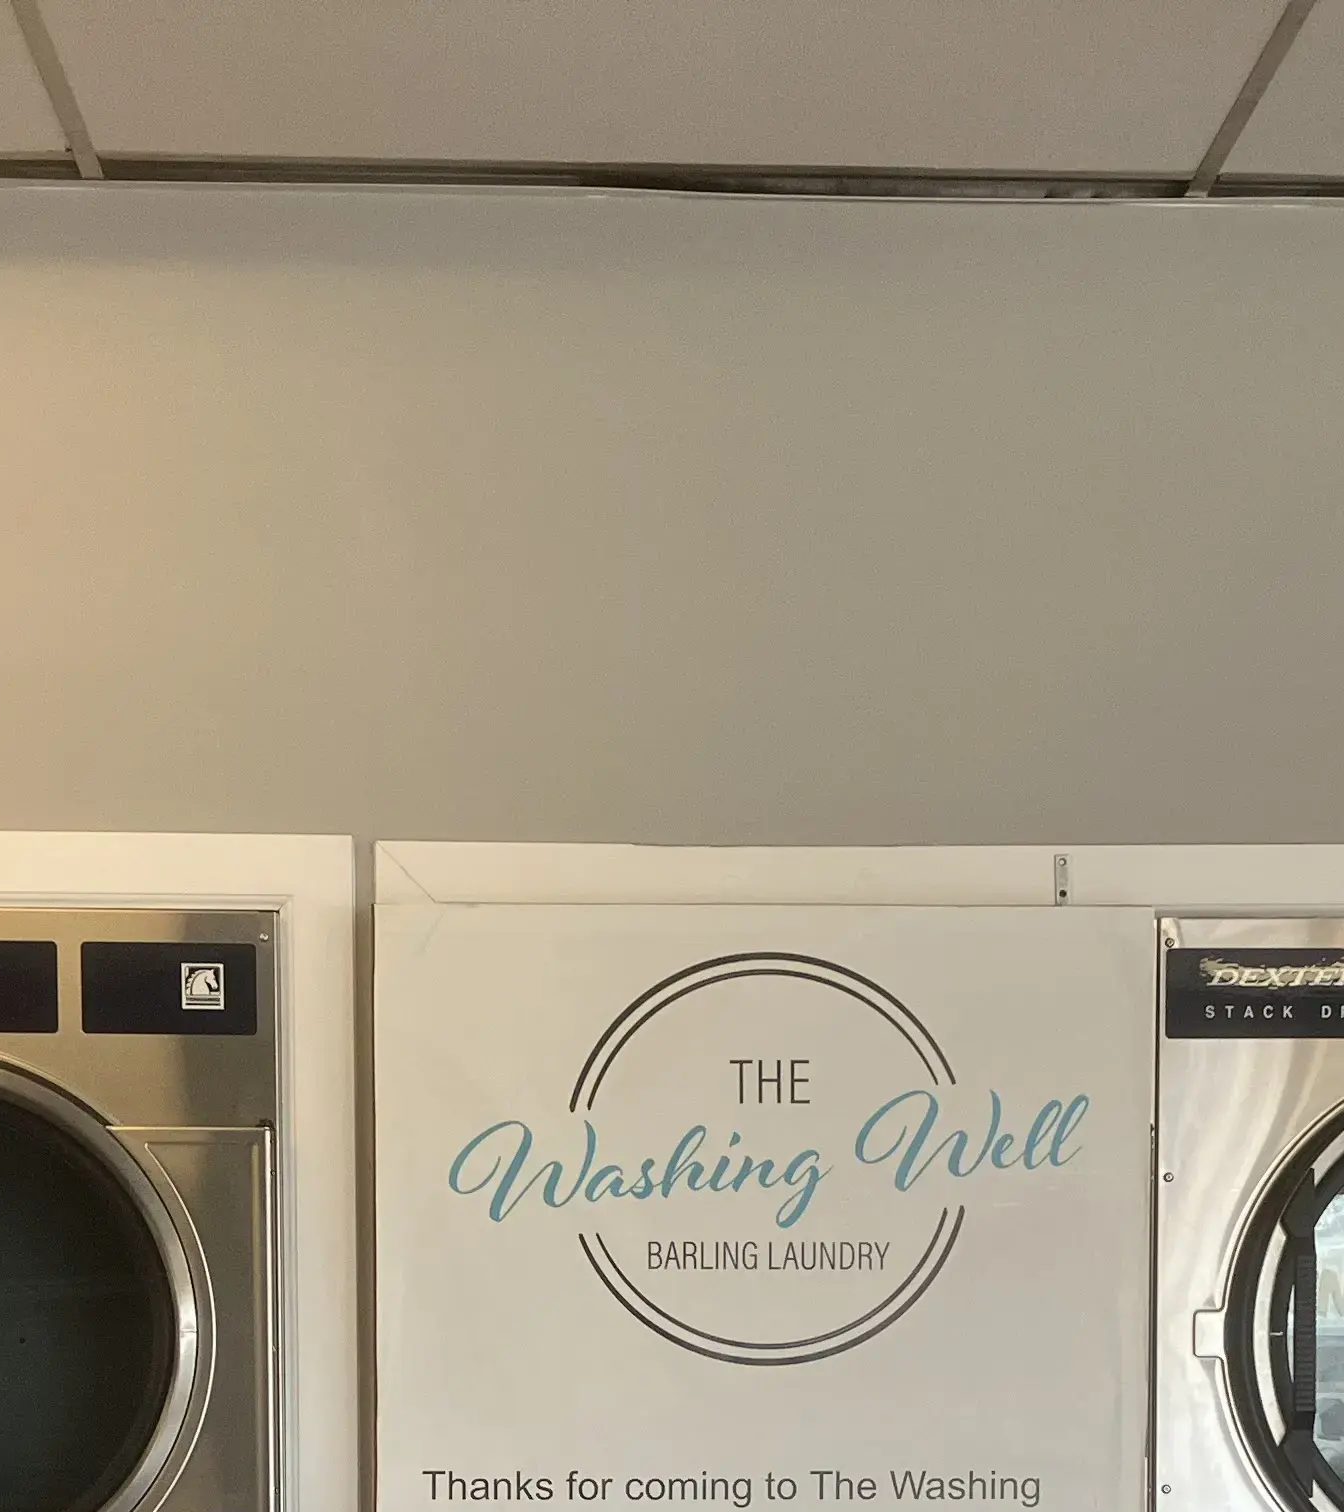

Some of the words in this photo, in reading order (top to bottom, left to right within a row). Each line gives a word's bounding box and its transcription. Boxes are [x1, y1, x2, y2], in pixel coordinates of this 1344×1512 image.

[1205, 1005, 1294, 1019] STACK
[729, 1059, 811, 1105] THE
[448, 1119, 833, 1228] Washing
[854, 1088, 1090, 1191] Well
[647, 1240, 758, 1270] BARLING
[768, 1241, 890, 1271] LAUNDRY
[421, 1470, 554, 1501] Thanks
[565, 1470, 614, 1501] for
[625, 1470, 752, 1509] coming
[764, 1471, 797, 1501] to
[809, 1470, 877, 1500] The
[889, 1470, 1040, 1508] Washing
